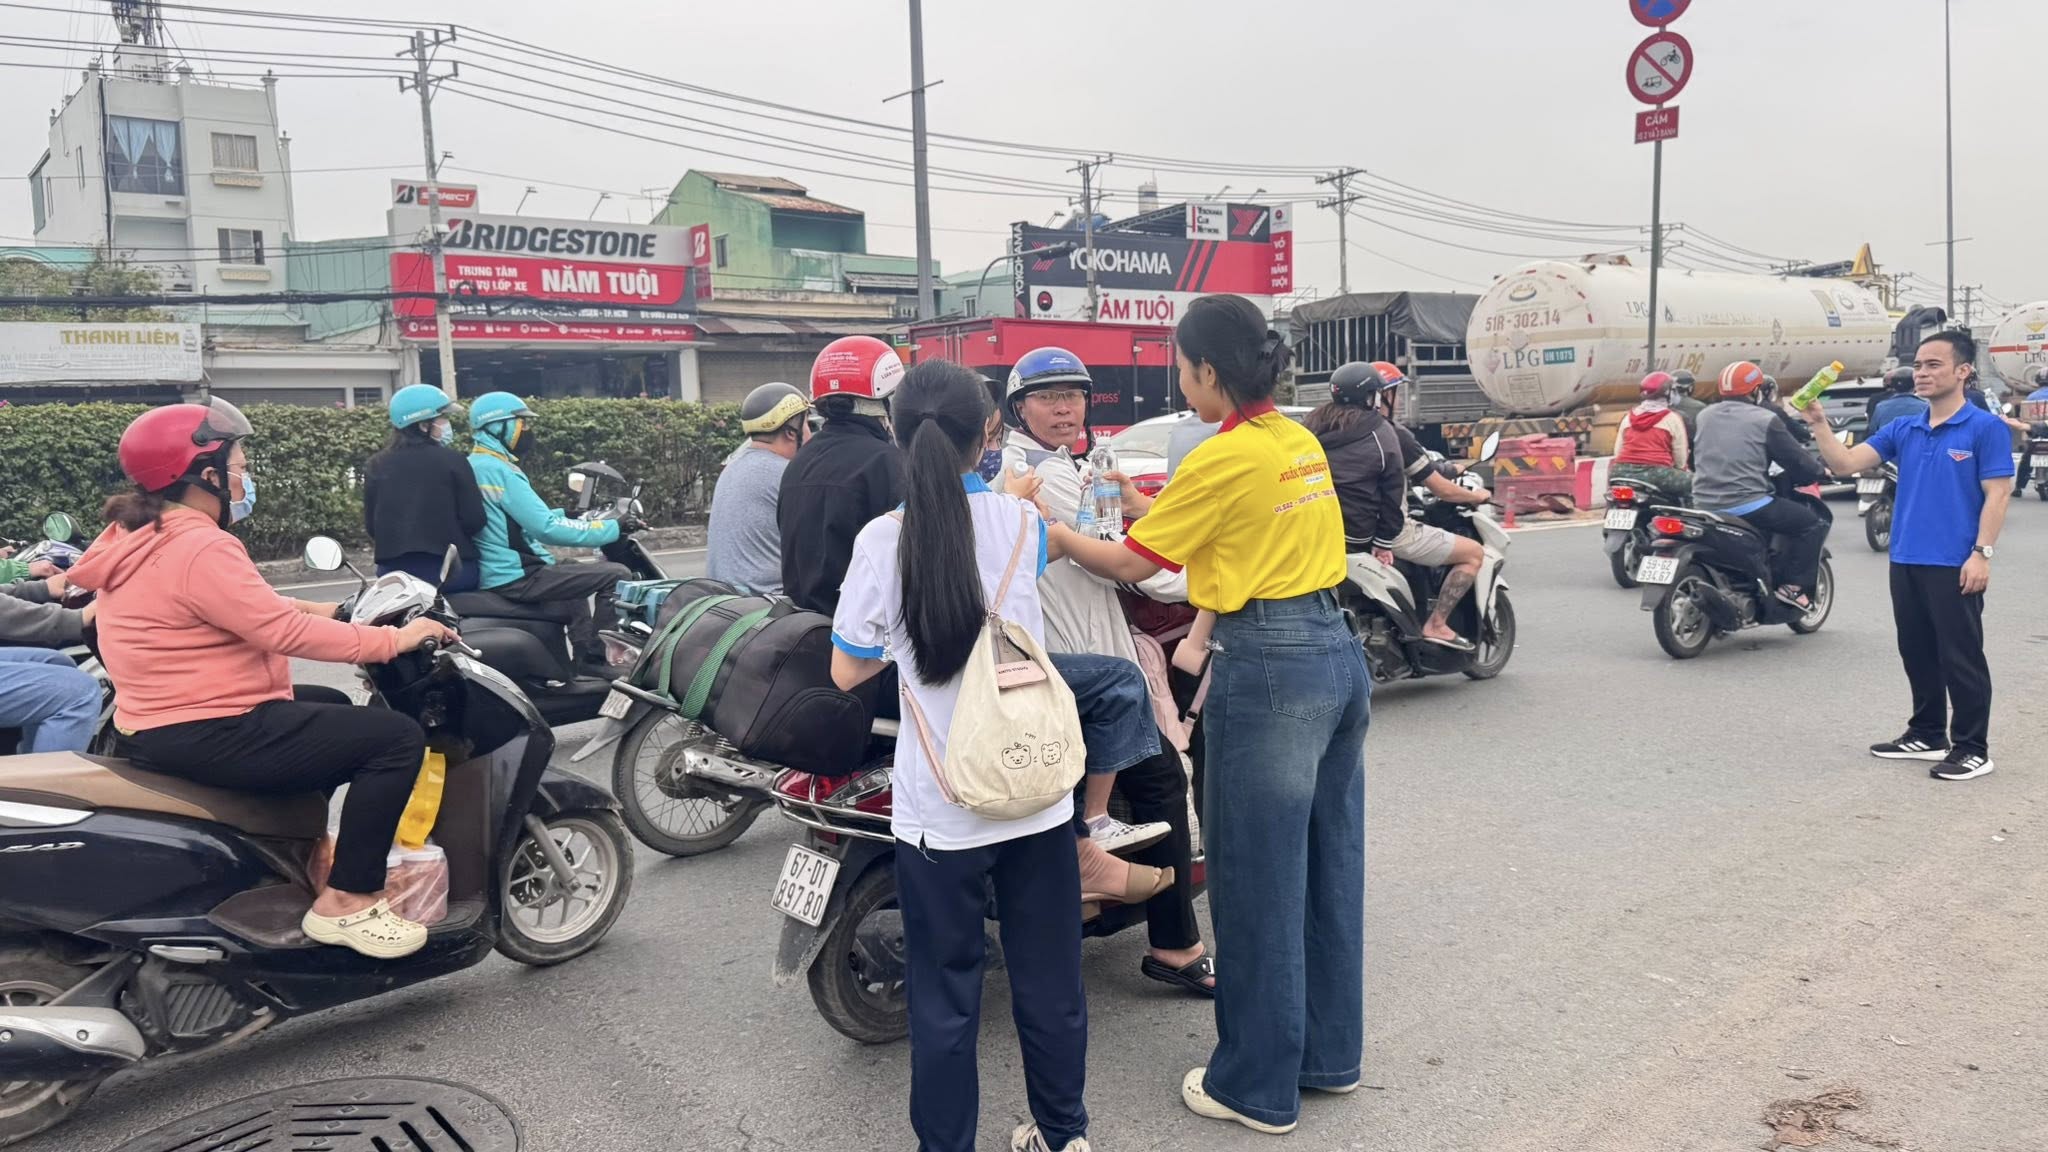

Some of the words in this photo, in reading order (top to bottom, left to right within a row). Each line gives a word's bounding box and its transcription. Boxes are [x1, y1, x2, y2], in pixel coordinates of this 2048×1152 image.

[445, 219, 657, 258] BRIDGESTONE
[457, 265, 493, 277] TRUNG
[495, 264, 518, 278] TÂM
[1069, 247, 1172, 275] YOKOHAMA
[514, 281, 528, 292] XE
[541, 265, 600, 294] NĂM
[606, 267, 659, 300] TUỘI
[1099, 293, 1130, 320] ĂM
[1135, 294, 1174, 325] TUỘI
[61, 330, 130, 345] THANH
[136, 328, 180, 346] LIÊM
[1502, 349, 1540, 370] LPG
[1090, 389, 1119, 407] press
